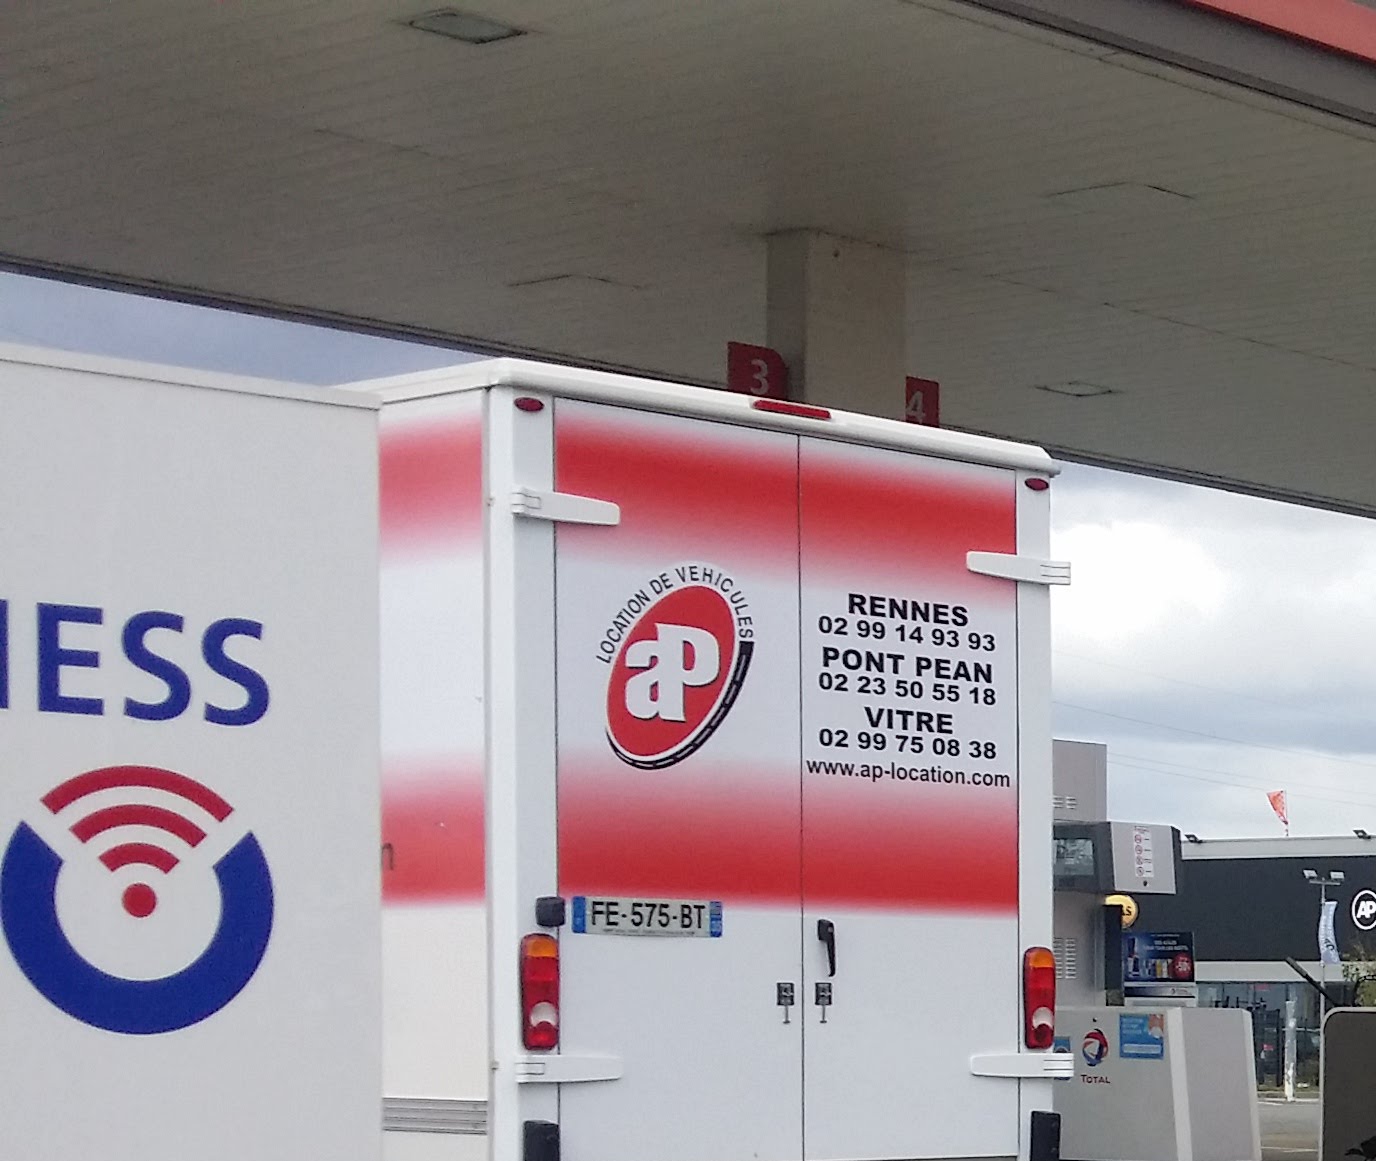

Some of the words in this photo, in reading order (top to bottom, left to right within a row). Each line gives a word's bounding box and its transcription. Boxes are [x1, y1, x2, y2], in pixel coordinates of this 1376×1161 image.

[750, 358, 769, 395] 3
[906, 390, 926, 424] 4
[596, 589, 651, 664] LOCATION
[649, 573, 673, 595] DE
[675, 565, 754, 639] VEHICULES
[848, 593, 969, 627] RENNES
[818, 616, 848, 636] 02
[856, 619, 886, 640] 99
[895, 624, 924, 644] 14
[931, 628, 960, 648] 93
[967, 632, 996, 652] 93
[822, 646, 905, 675] PONT
[915, 656, 992, 684] PEAN
[818, 672, 849, 692] 02
[856, 675, 886, 696] 23
[895, 680, 924, 699] 50
[932, 683, 960, 702] 55
[969, 687, 996, 706] 18
[864, 706, 954, 735] VITRE
[819, 728, 849, 748] 02
[857, 731, 887, 751] 99
[895, 735, 924, 754] 75
[932, 738, 960, 757] 08
[969, 741, 997, 760] 38
[806, 760, 1011, 788] www.ap-location.com
[591, 900, 706, 929] FE-575-BT
[1081, 1074, 1111, 1084] TOTAL
